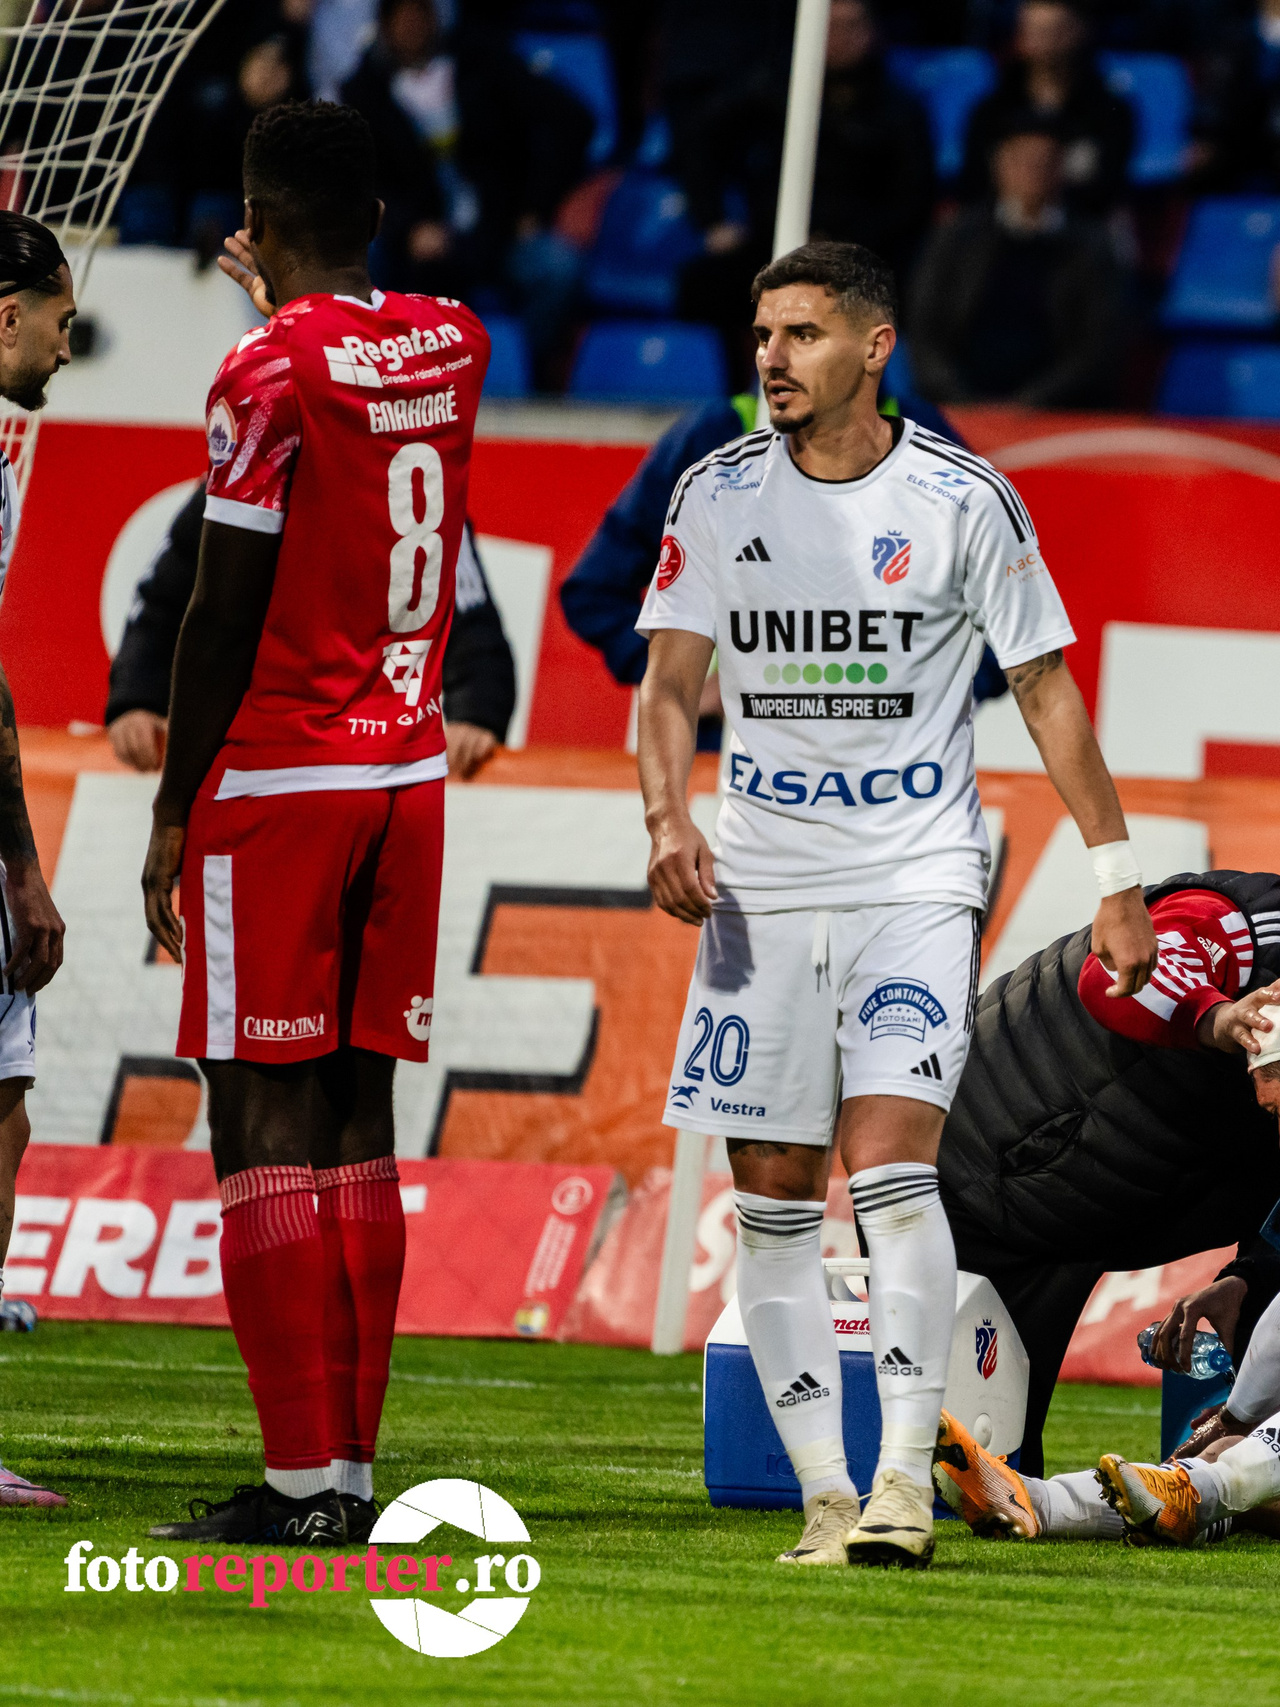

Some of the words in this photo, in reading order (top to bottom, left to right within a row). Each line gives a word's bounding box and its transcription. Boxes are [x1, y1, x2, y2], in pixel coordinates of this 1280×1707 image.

[341, 322, 463, 372] Regata.ro
[366, 384, 458, 434] GNAHORÉ
[388, 442, 444, 633] 8
[730, 609, 924, 653] UNIBET
[749, 694, 827, 717] ÎMPREUNĂ
[831, 699, 874, 717] SPRE
[878, 698, 903, 716] 0%
[729, 753, 943, 806] ELSACO
[860, 997, 879, 1020] FIVE
[879, 987, 944, 1023] CONTINENTS
[244, 1013, 325, 1041] CARPATINA
[684, 1006, 750, 1087] 20
[710, 1097, 766, 1117] Vestra
[877, 1363, 923, 1377] adidas
[776, 1386, 830, 1408] adidas
